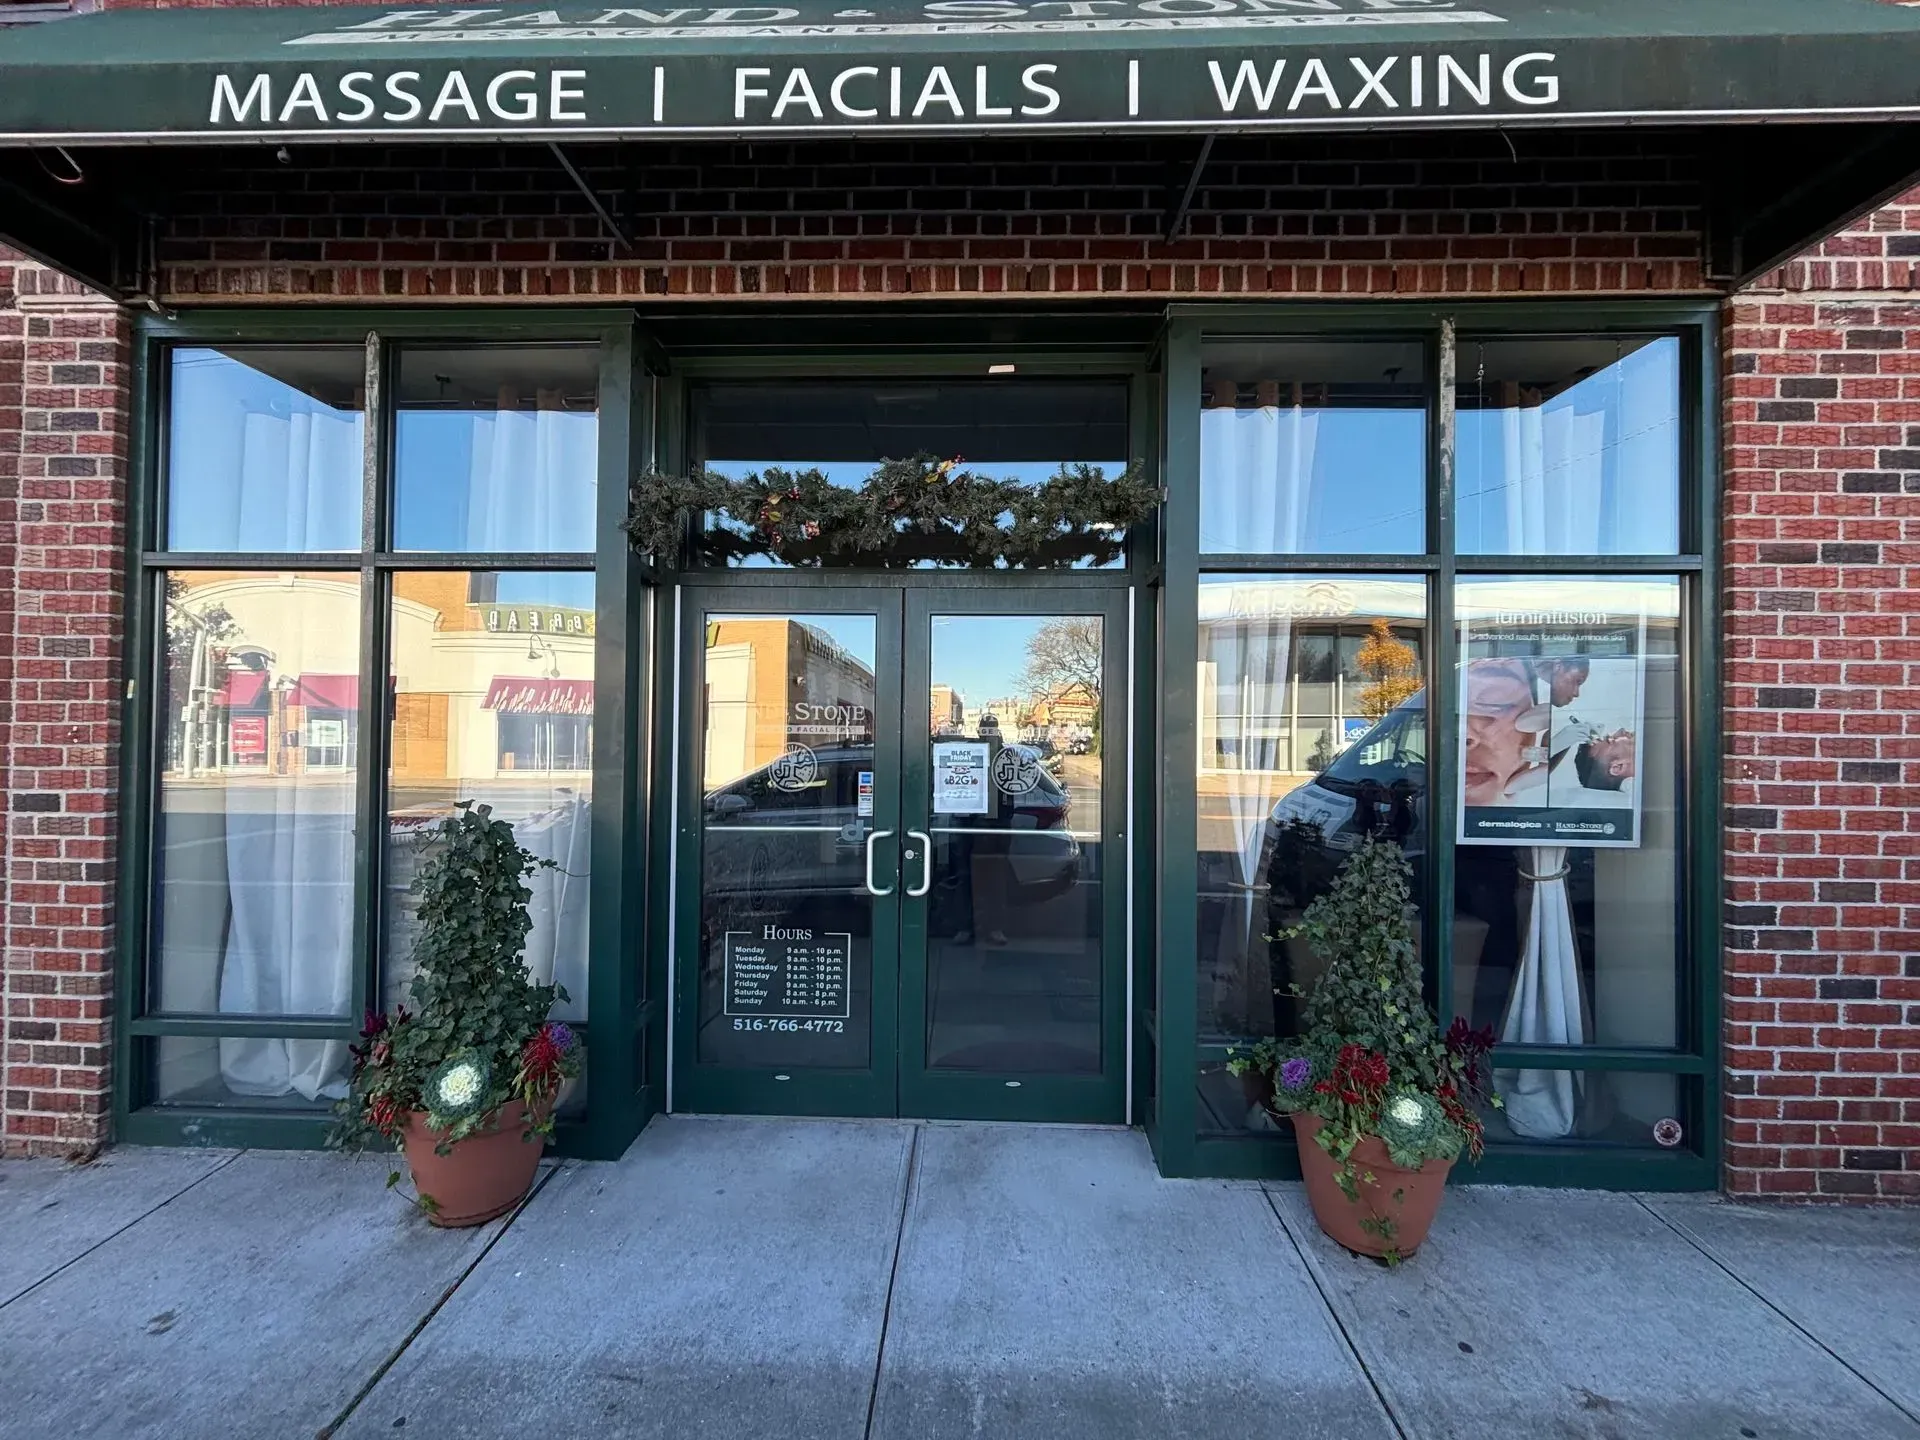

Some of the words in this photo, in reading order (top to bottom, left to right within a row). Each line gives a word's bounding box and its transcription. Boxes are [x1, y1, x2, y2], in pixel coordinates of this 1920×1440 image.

[336, 8, 799, 29] HAND
[833, 9, 876, 18] &
[369, 29, 708, 40] MASSAGE
[747, 26, 889, 34] AND
[937, 18, 1205, 32] FACIAL
[1247, 15, 1383, 25] SPA
[210, 70, 587, 123] MASSAGE
[734, 63, 1061, 119] FACIALS
[1207, 52, 1559, 112] WAXING
[795, 702, 865, 721] STONE
[1478, 821, 1542, 829] dermalogica
[735, 946, 765, 954] Monday
[735, 955, 766, 963] Tuesday
[734, 963, 779, 971] Wednesday
[735, 972, 770, 980] Thursday
[734, 980, 758, 988] Friday
[734, 989, 768, 997] Saturday
[734, 997, 763, 1005] Sunday
[733, 1019, 844, 1033] 516-766-4772
